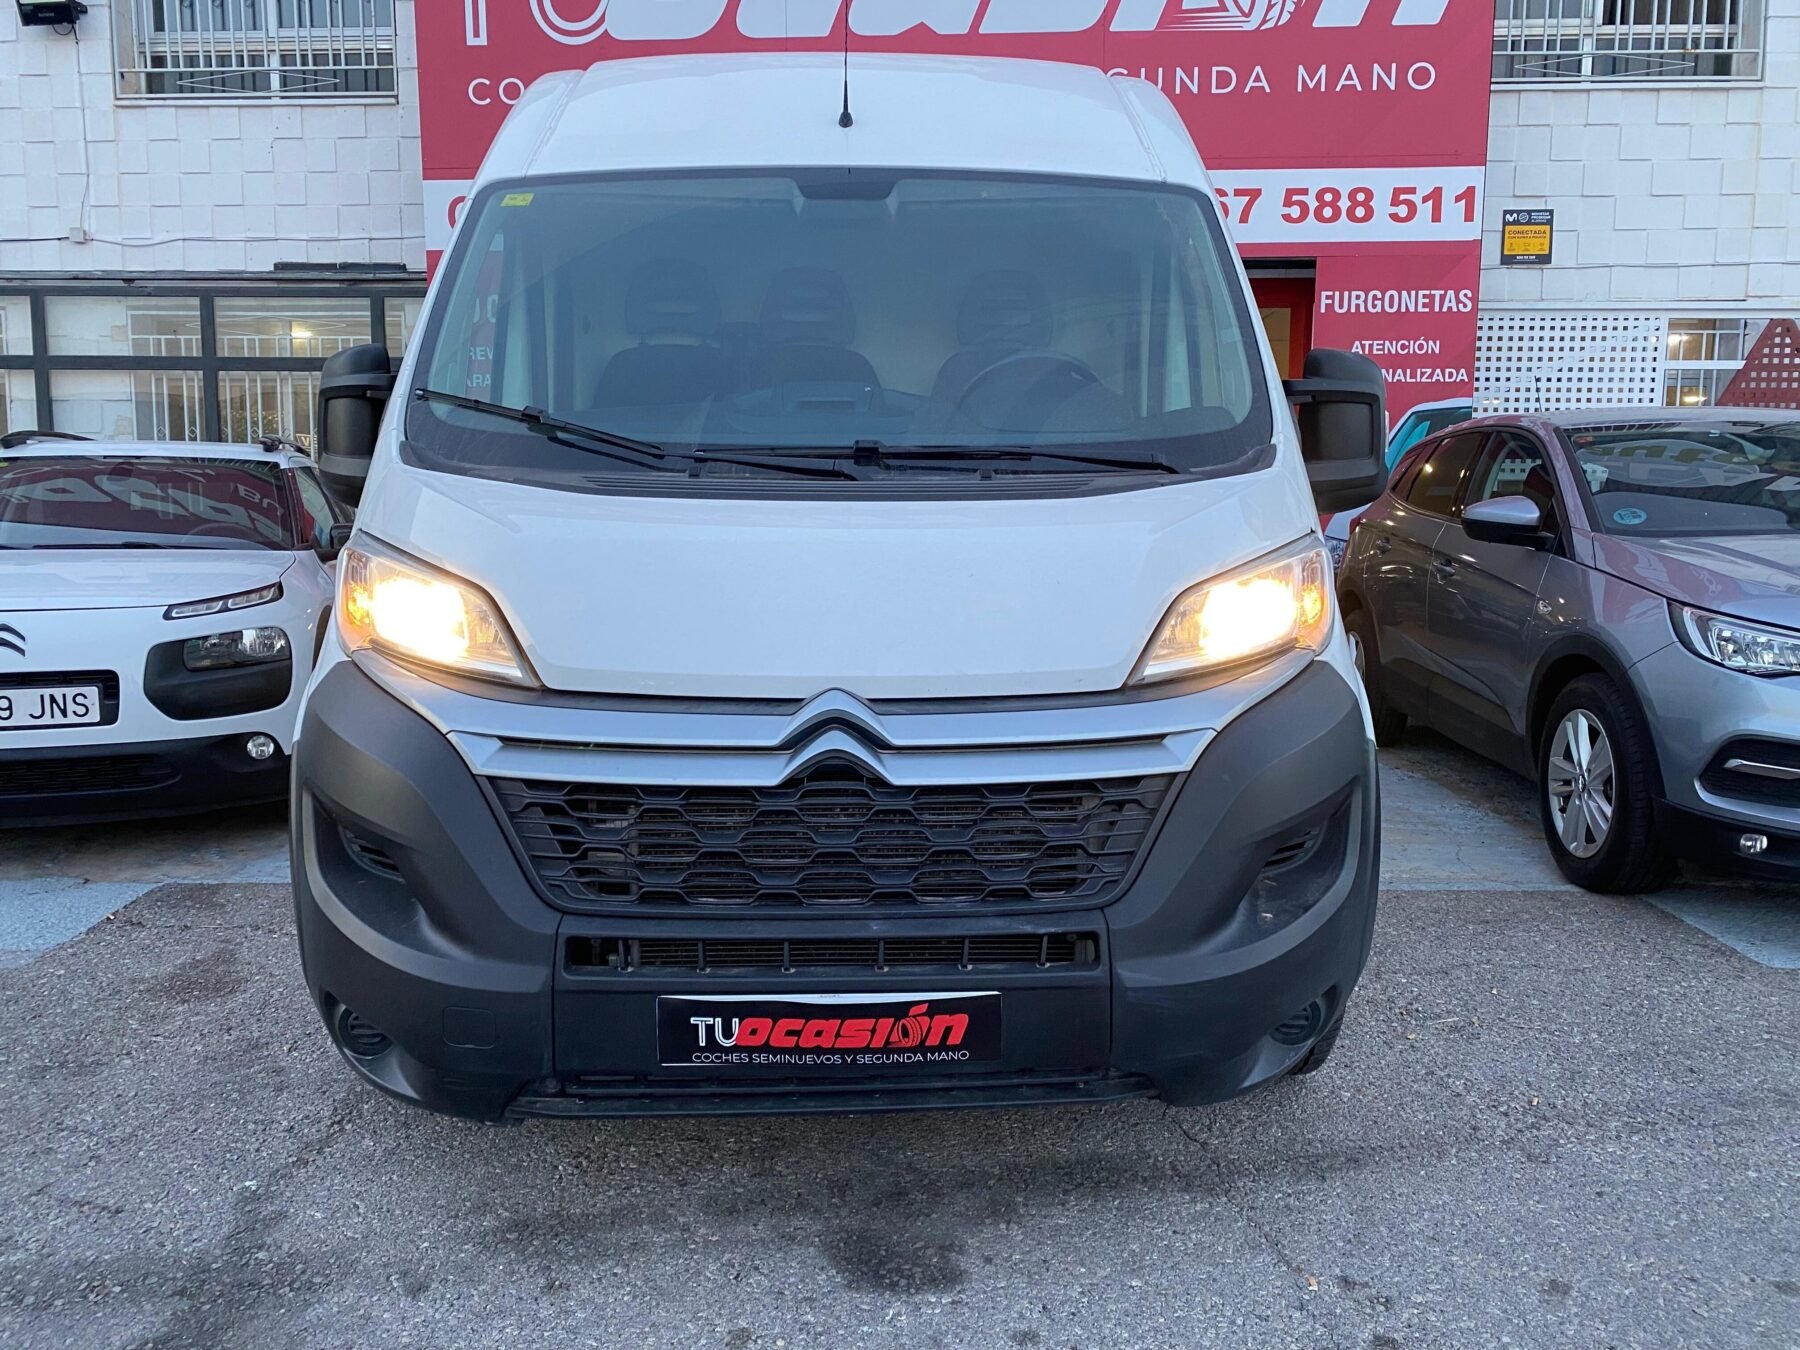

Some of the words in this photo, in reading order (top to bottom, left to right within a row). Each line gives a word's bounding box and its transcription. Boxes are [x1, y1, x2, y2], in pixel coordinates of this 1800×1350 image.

[1297, 61, 1436, 93] MANO
[1280, 186, 1375, 224] 588
[1388, 185, 1476, 223] 511
[1320, 289, 1473, 313] FURGONETAS
[1351, 337, 1440, 354] ATENCIÓN
[28, 692, 90, 720] JNS
[692, 1053, 749, 1063] COCHES
[752, 1053, 842, 1065] SEMINUEVOS
[845, 1054, 854, 1064] Y
[856, 1053, 924, 1064] SEGUNDA
[927, 1050, 970, 1061] MANO
